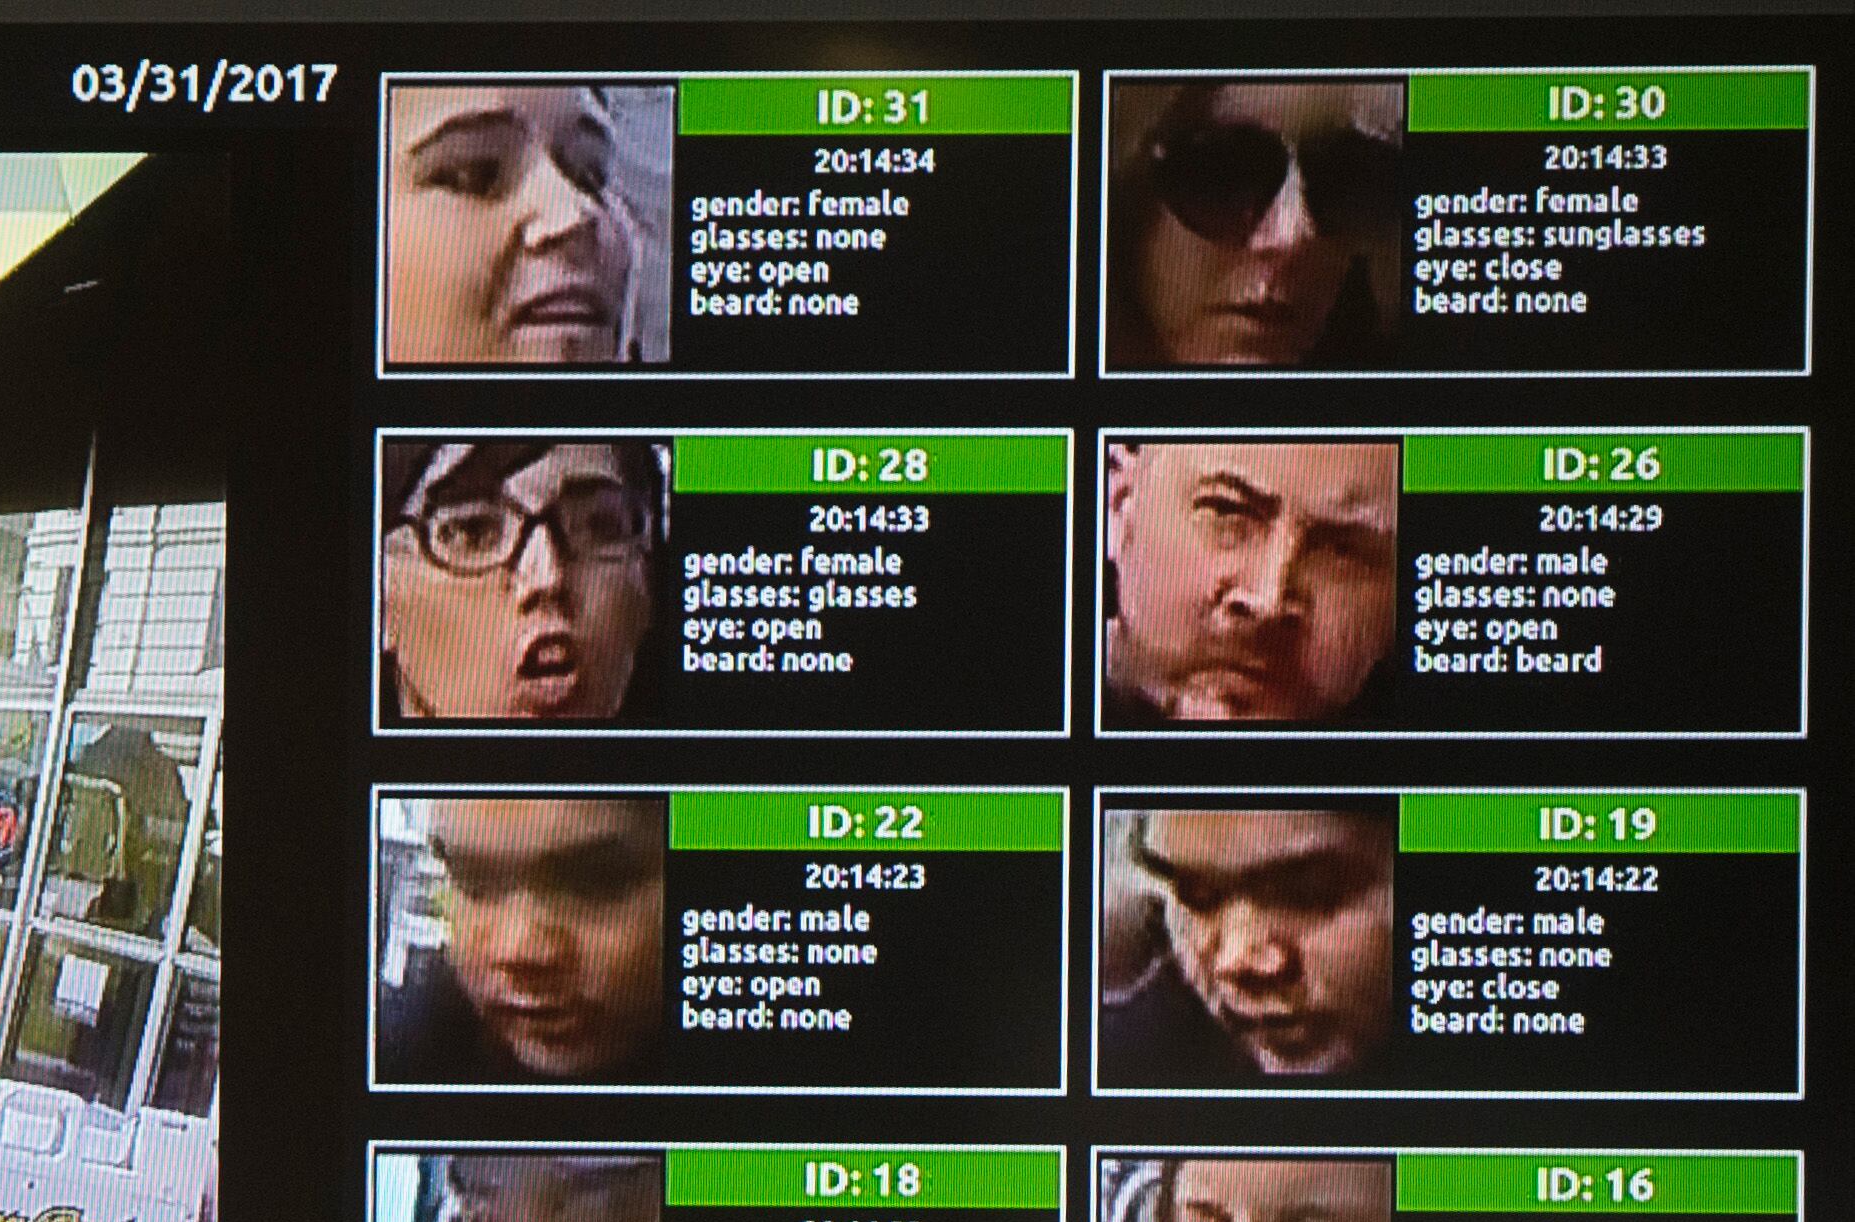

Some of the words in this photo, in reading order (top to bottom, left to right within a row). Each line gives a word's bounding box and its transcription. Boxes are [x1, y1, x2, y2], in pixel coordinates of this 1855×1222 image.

[71, 58, 338, 113] 03/31/2017
[817, 88, 875, 125] ID:
[883, 88, 929, 125] 31
[1549, 85, 1606, 121] ID:
[1615, 85, 1666, 120] 30
[814, 147, 937, 174] 20:14:34
[1544, 144, 1668, 170] 20:14:33
[689, 188, 801, 222] gender:
[807, 188, 910, 217] female
[1413, 186, 1528, 220] gender:
[1535, 185, 1639, 214] female
[689, 221, 808, 255] glasses:
[815, 228, 887, 251] none
[1413, 218, 1535, 252] glasses:
[1543, 217, 1706, 251] sunglasses
[689, 261, 752, 289] eye:
[757, 260, 830, 288] open
[1413, 258, 1477, 287] eye:
[1484, 251, 1563, 281] close
[689, 286, 783, 316] beard:
[787, 293, 860, 316] none
[1413, 284, 1509, 314] beard:
[1515, 291, 1587, 314] none
[812, 447, 870, 482] ID:
[878, 447, 929, 482] 28
[1544, 446, 1601, 481] ID:
[1610, 445, 1662, 481] 26
[809, 504, 930, 533] 20:14:33
[1539, 504, 1664, 533] 20:14:29
[683, 545, 794, 581] gender:
[800, 545, 903, 576] female
[1414, 545, 1528, 581] gender:
[1535, 545, 1609, 576] male
[682, 577, 801, 613] glasses:
[806, 578, 918, 613] glasses
[1414, 578, 1536, 614] glasses:
[1542, 585, 1617, 608] none
[683, 617, 746, 645] eye:
[750, 617, 822, 646] open
[1413, 618, 1478, 646] eye:
[1484, 618, 1558, 646] open
[682, 643, 775, 673] beard:
[780, 651, 854, 673] none
[1413, 644, 1508, 673] beard:
[1515, 644, 1603, 673] beard
[808, 804, 866, 839] ID:
[874, 805, 925, 839] 22
[1539, 807, 1597, 841] ID:
[1608, 807, 1658, 841] 19
[805, 862, 927, 890] 20:14:23
[1534, 865, 1659, 892] 20:14:22
[680, 902, 792, 937] gender:
[799, 903, 871, 933] male
[1410, 905, 1525, 940] gender:
[1531, 906, 1605, 936] male
[680, 935, 800, 969] glasses:
[807, 943, 878, 965] none
[1410, 938, 1533, 973] glasses:
[1538, 947, 1613, 968] none
[680, 975, 744, 1001] eye:
[749, 975, 821, 1002] open
[1410, 979, 1474, 1005] eye:
[1481, 971, 1560, 1000] close
[681, 999, 774, 1031] beard:
[779, 1008, 853, 1031] none
[1409, 1003, 1505, 1035] beard:
[1512, 1012, 1585, 1035] none
[805, 1161, 863, 1198] ID:
[872, 1161, 922, 1198] 18
[1537, 1166, 1595, 1203] ID:
[1605, 1167, 1656, 1203] 16
